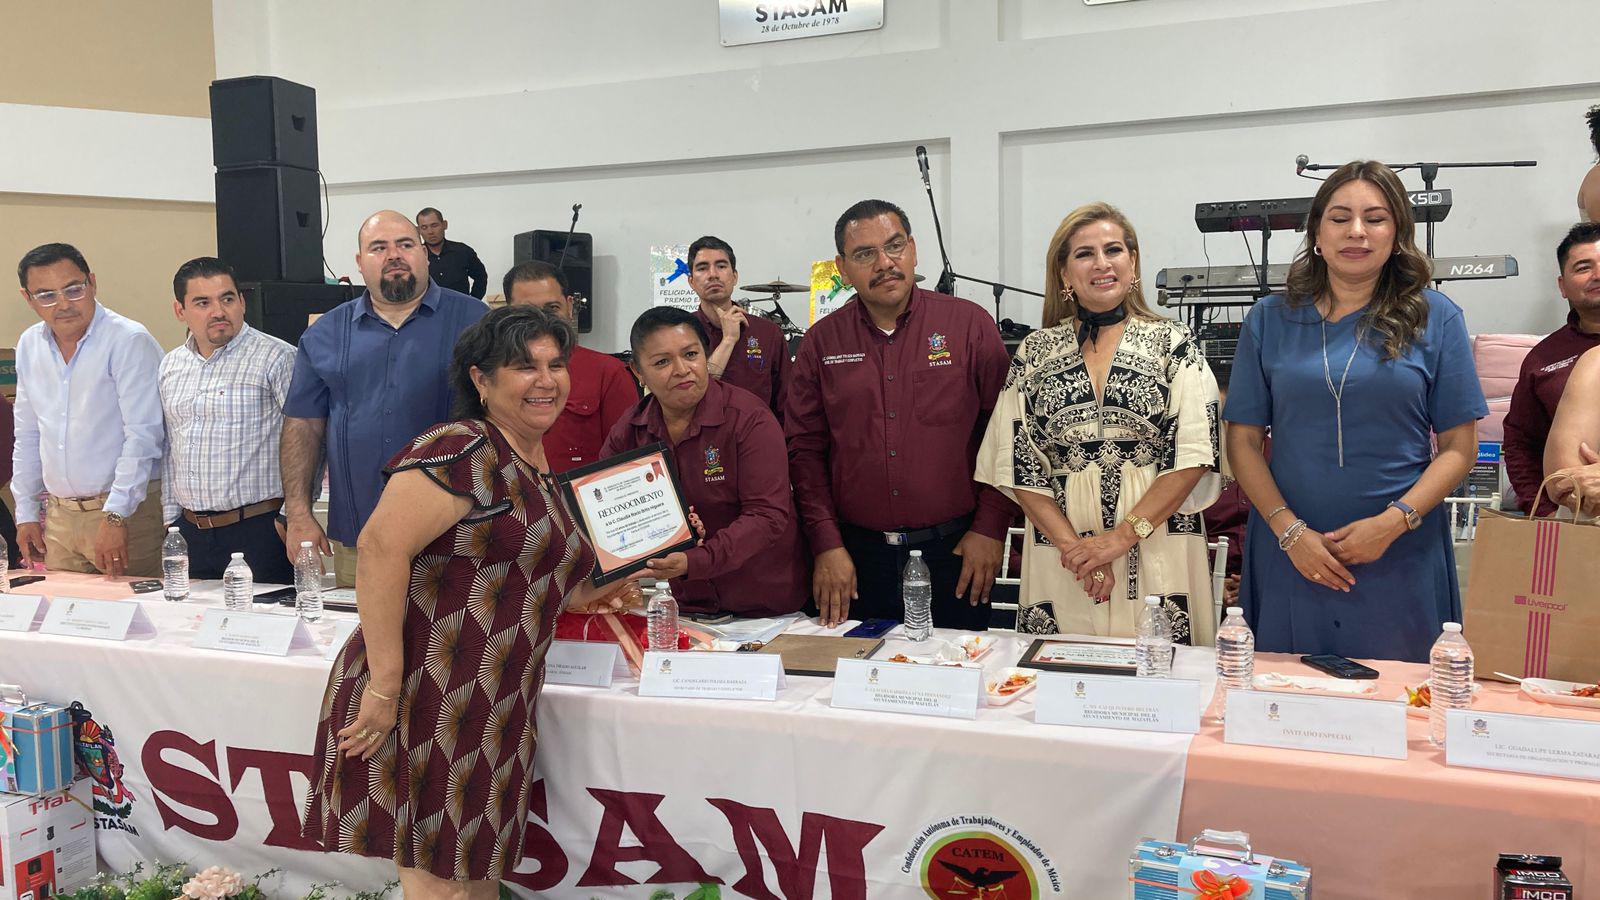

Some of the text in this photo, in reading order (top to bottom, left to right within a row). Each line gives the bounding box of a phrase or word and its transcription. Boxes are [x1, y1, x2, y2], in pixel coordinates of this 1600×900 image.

[755, 0, 848, 22] STASAM
[782, 21, 810, 31] Octubre
[823, 17, 840, 26] 1978
[1450, 264, 1494, 275] N264
[598, 490, 664, 519] RECONOCIMIENTO
[1528, 599, 1566, 611] Liverpool
[1282, 729, 1352, 740] INVITADO ESPECIAL
[1508, 745, 1547, 754] GUADALUPE
[94, 818, 140, 837] STASAM
[902, 837, 925, 874] Confederación
[923, 819, 951, 839] Autónoma
[951, 817, 960, 826] de
[960, 816, 1006, 831] Trabajadores
[1012, 830, 1043, 860] Empleados
[1041, 857, 1050, 867] de
[1048, 867, 1060, 892] México
[952, 847, 1005, 862] CATEM
[1522, 890, 1566, 900] IMCO
